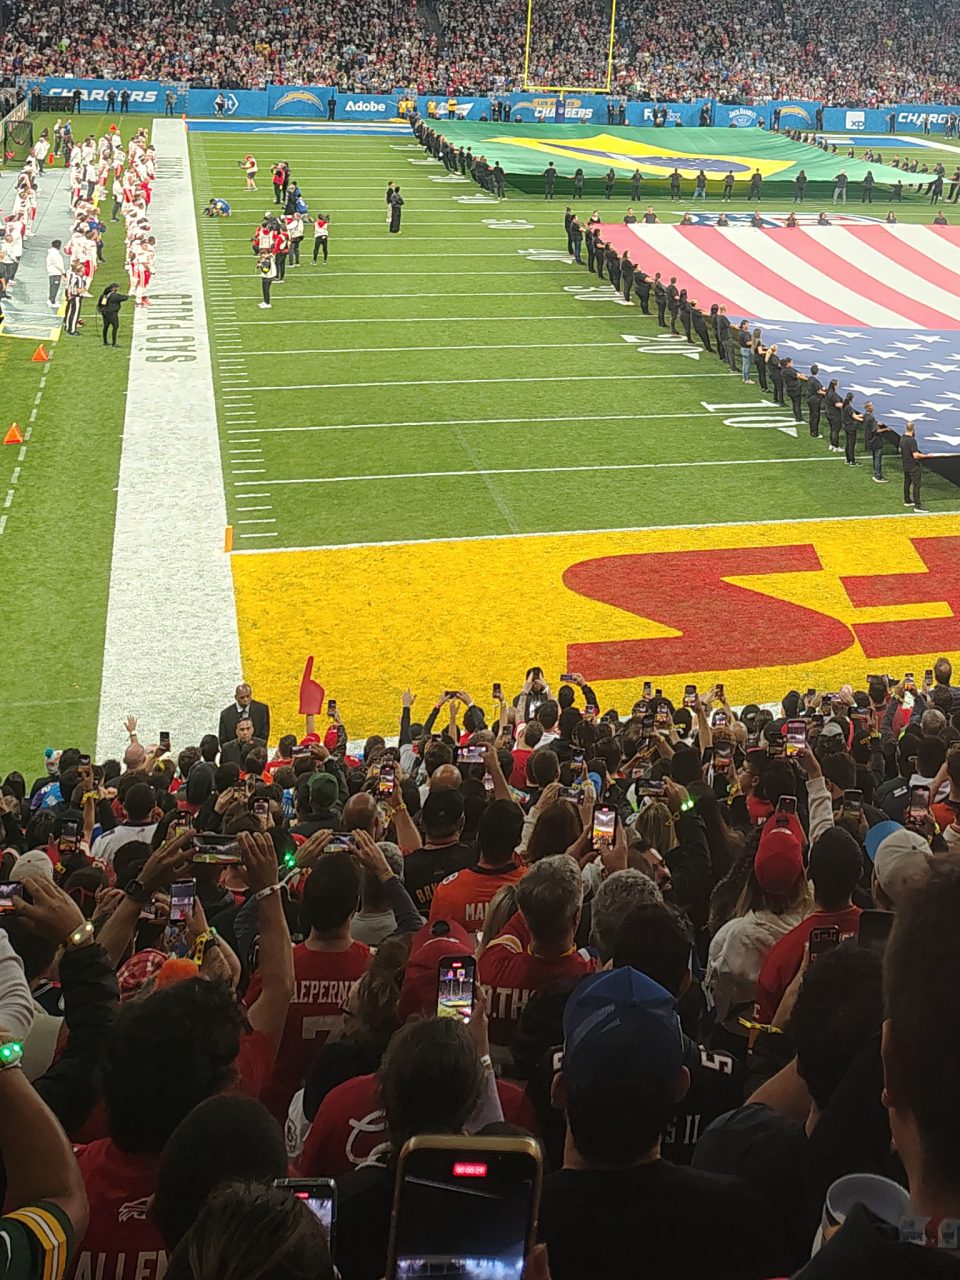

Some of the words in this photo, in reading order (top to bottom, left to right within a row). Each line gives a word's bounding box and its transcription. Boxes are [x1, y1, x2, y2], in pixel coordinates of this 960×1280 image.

[345, 100, 386, 111] Adobe
[534, 107, 593, 119] CHAGERS
[643, 108, 681, 120] FEx
[563, 285, 633, 301] 30
[146, 294, 195, 331] PAULO
[137, 334, 197, 363] SÃO
[620, 334, 704, 354] 20
[700, 399, 808, 428] 10
[290, 980, 353, 1004] AEPERN
[482, 984, 536, 1019] .TH
